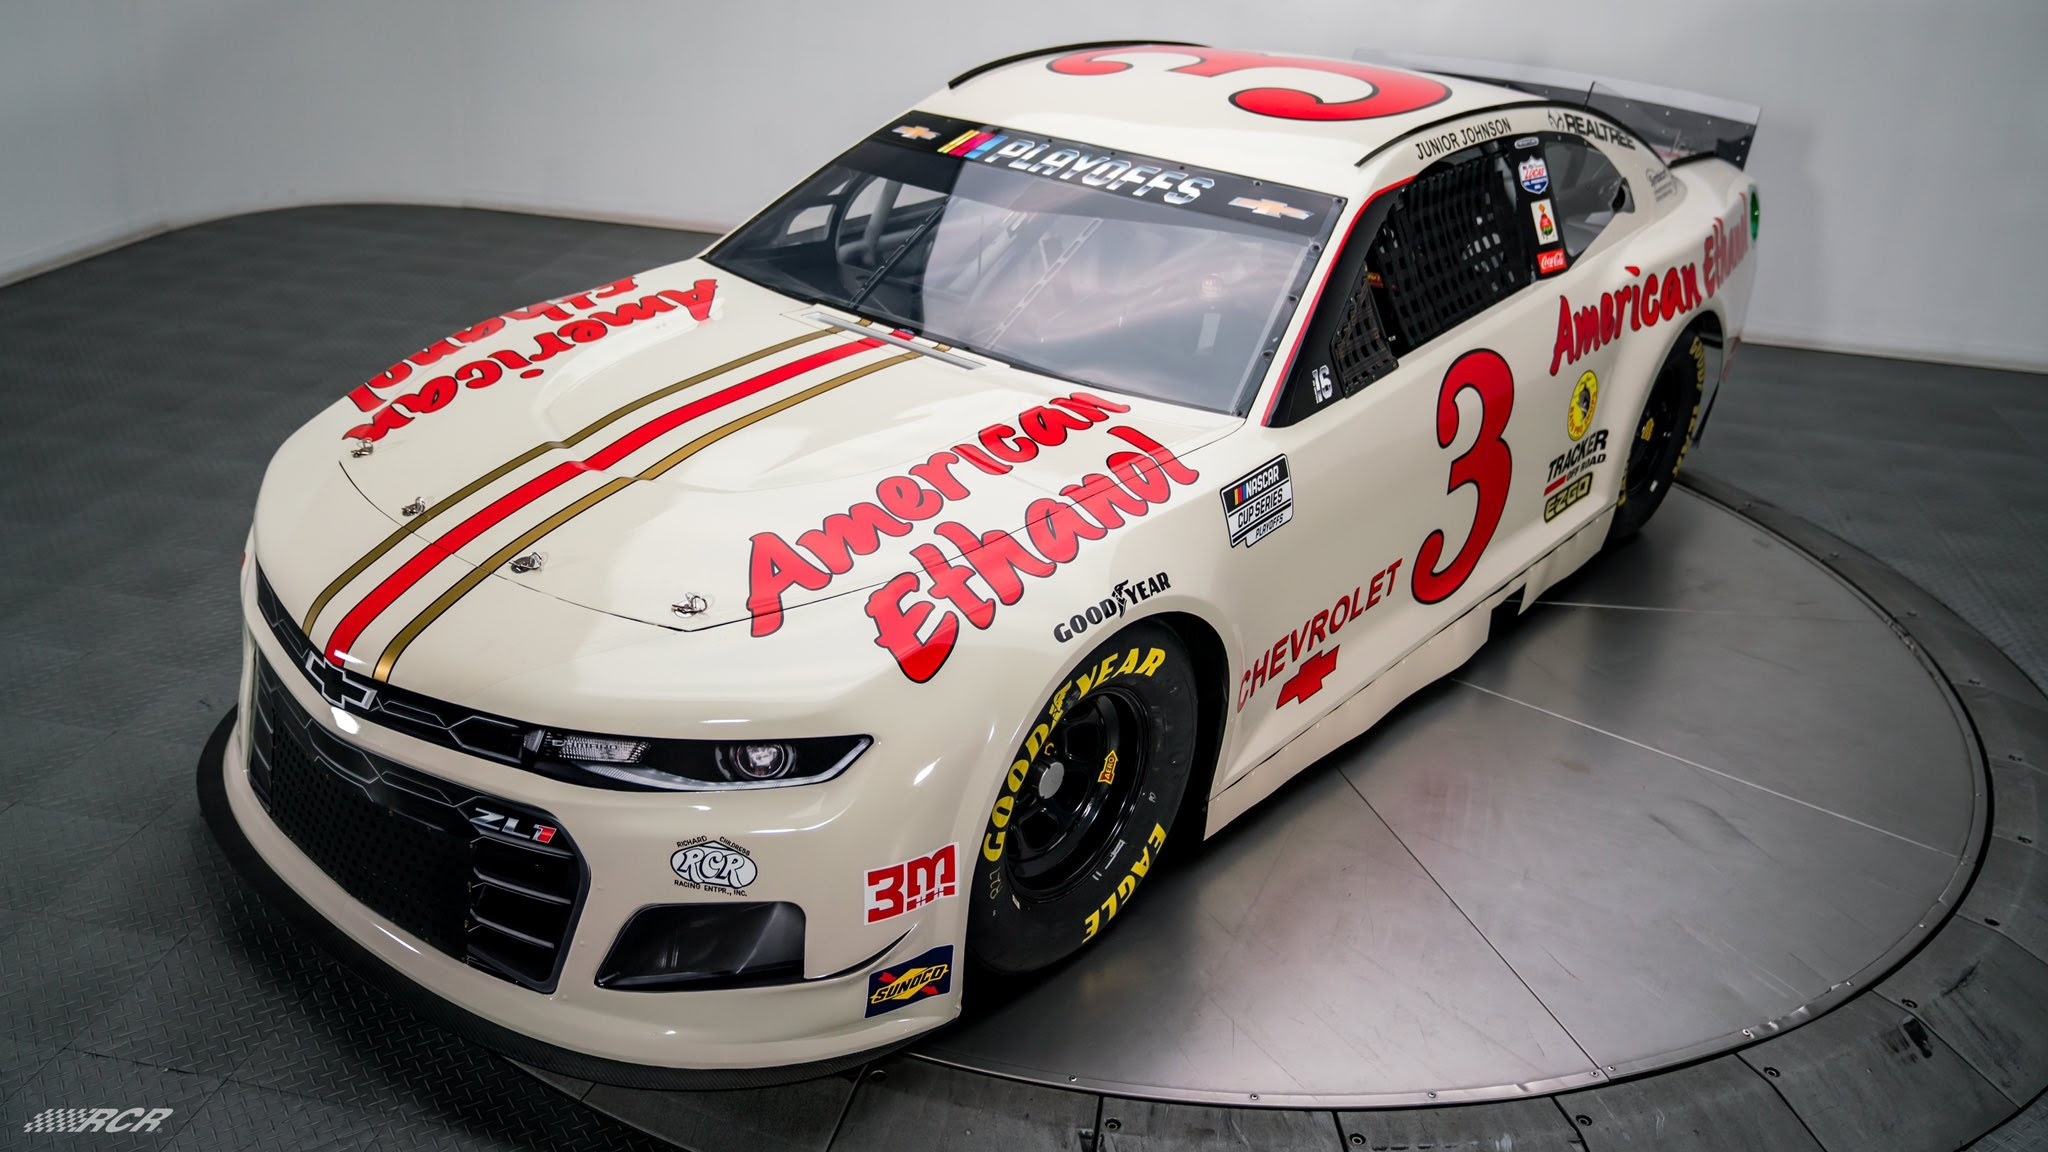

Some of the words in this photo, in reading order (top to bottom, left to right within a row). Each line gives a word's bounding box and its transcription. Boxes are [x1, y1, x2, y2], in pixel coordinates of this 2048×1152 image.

[1046, 44, 1452, 122] 3
[1415, 132, 1461, 161] JUNIOR
[1461, 117, 1513, 145] JOHNSON
[1564, 112, 1636, 151] REALTREE
[985, 138, 1214, 207] PLAYOFFS
[1550, 264, 1702, 376] American
[341, 279, 718, 441] American
[1312, 364, 1333, 404] 16
[1411, 348, 1515, 605] 3
[1547, 429, 1609, 482] TRACKER
[1567, 465, 1581, 481] OFF
[1580, 454, 1606, 473] ROAD
[1246, 465, 1280, 499] NASCAR
[746, 391, 1131, 638] American
[1237, 505, 1254, 529] CUP
[1254, 487, 1283, 517] SERIES
[1255, 513, 1284, 539] PLAYOFFS
[864, 426, 1200, 684] Ethanol
[1237, 557, 1403, 713] CHEVROLET
[1104, 757, 1116, 781] AERO
[469, 807, 558, 844] ZL1
[676, 835, 708, 848] RICHARD
[719, 836, 751, 857] CHILDRESS
[674, 879, 701, 890] RACING
[733, 888, 748, 898] INC.
[677, 848, 746, 889] RCR
[867, 844, 956, 923] 3M
[1081, 823, 1167, 944] EAGLE
[873, 965, 946, 1002] SUNOCO
